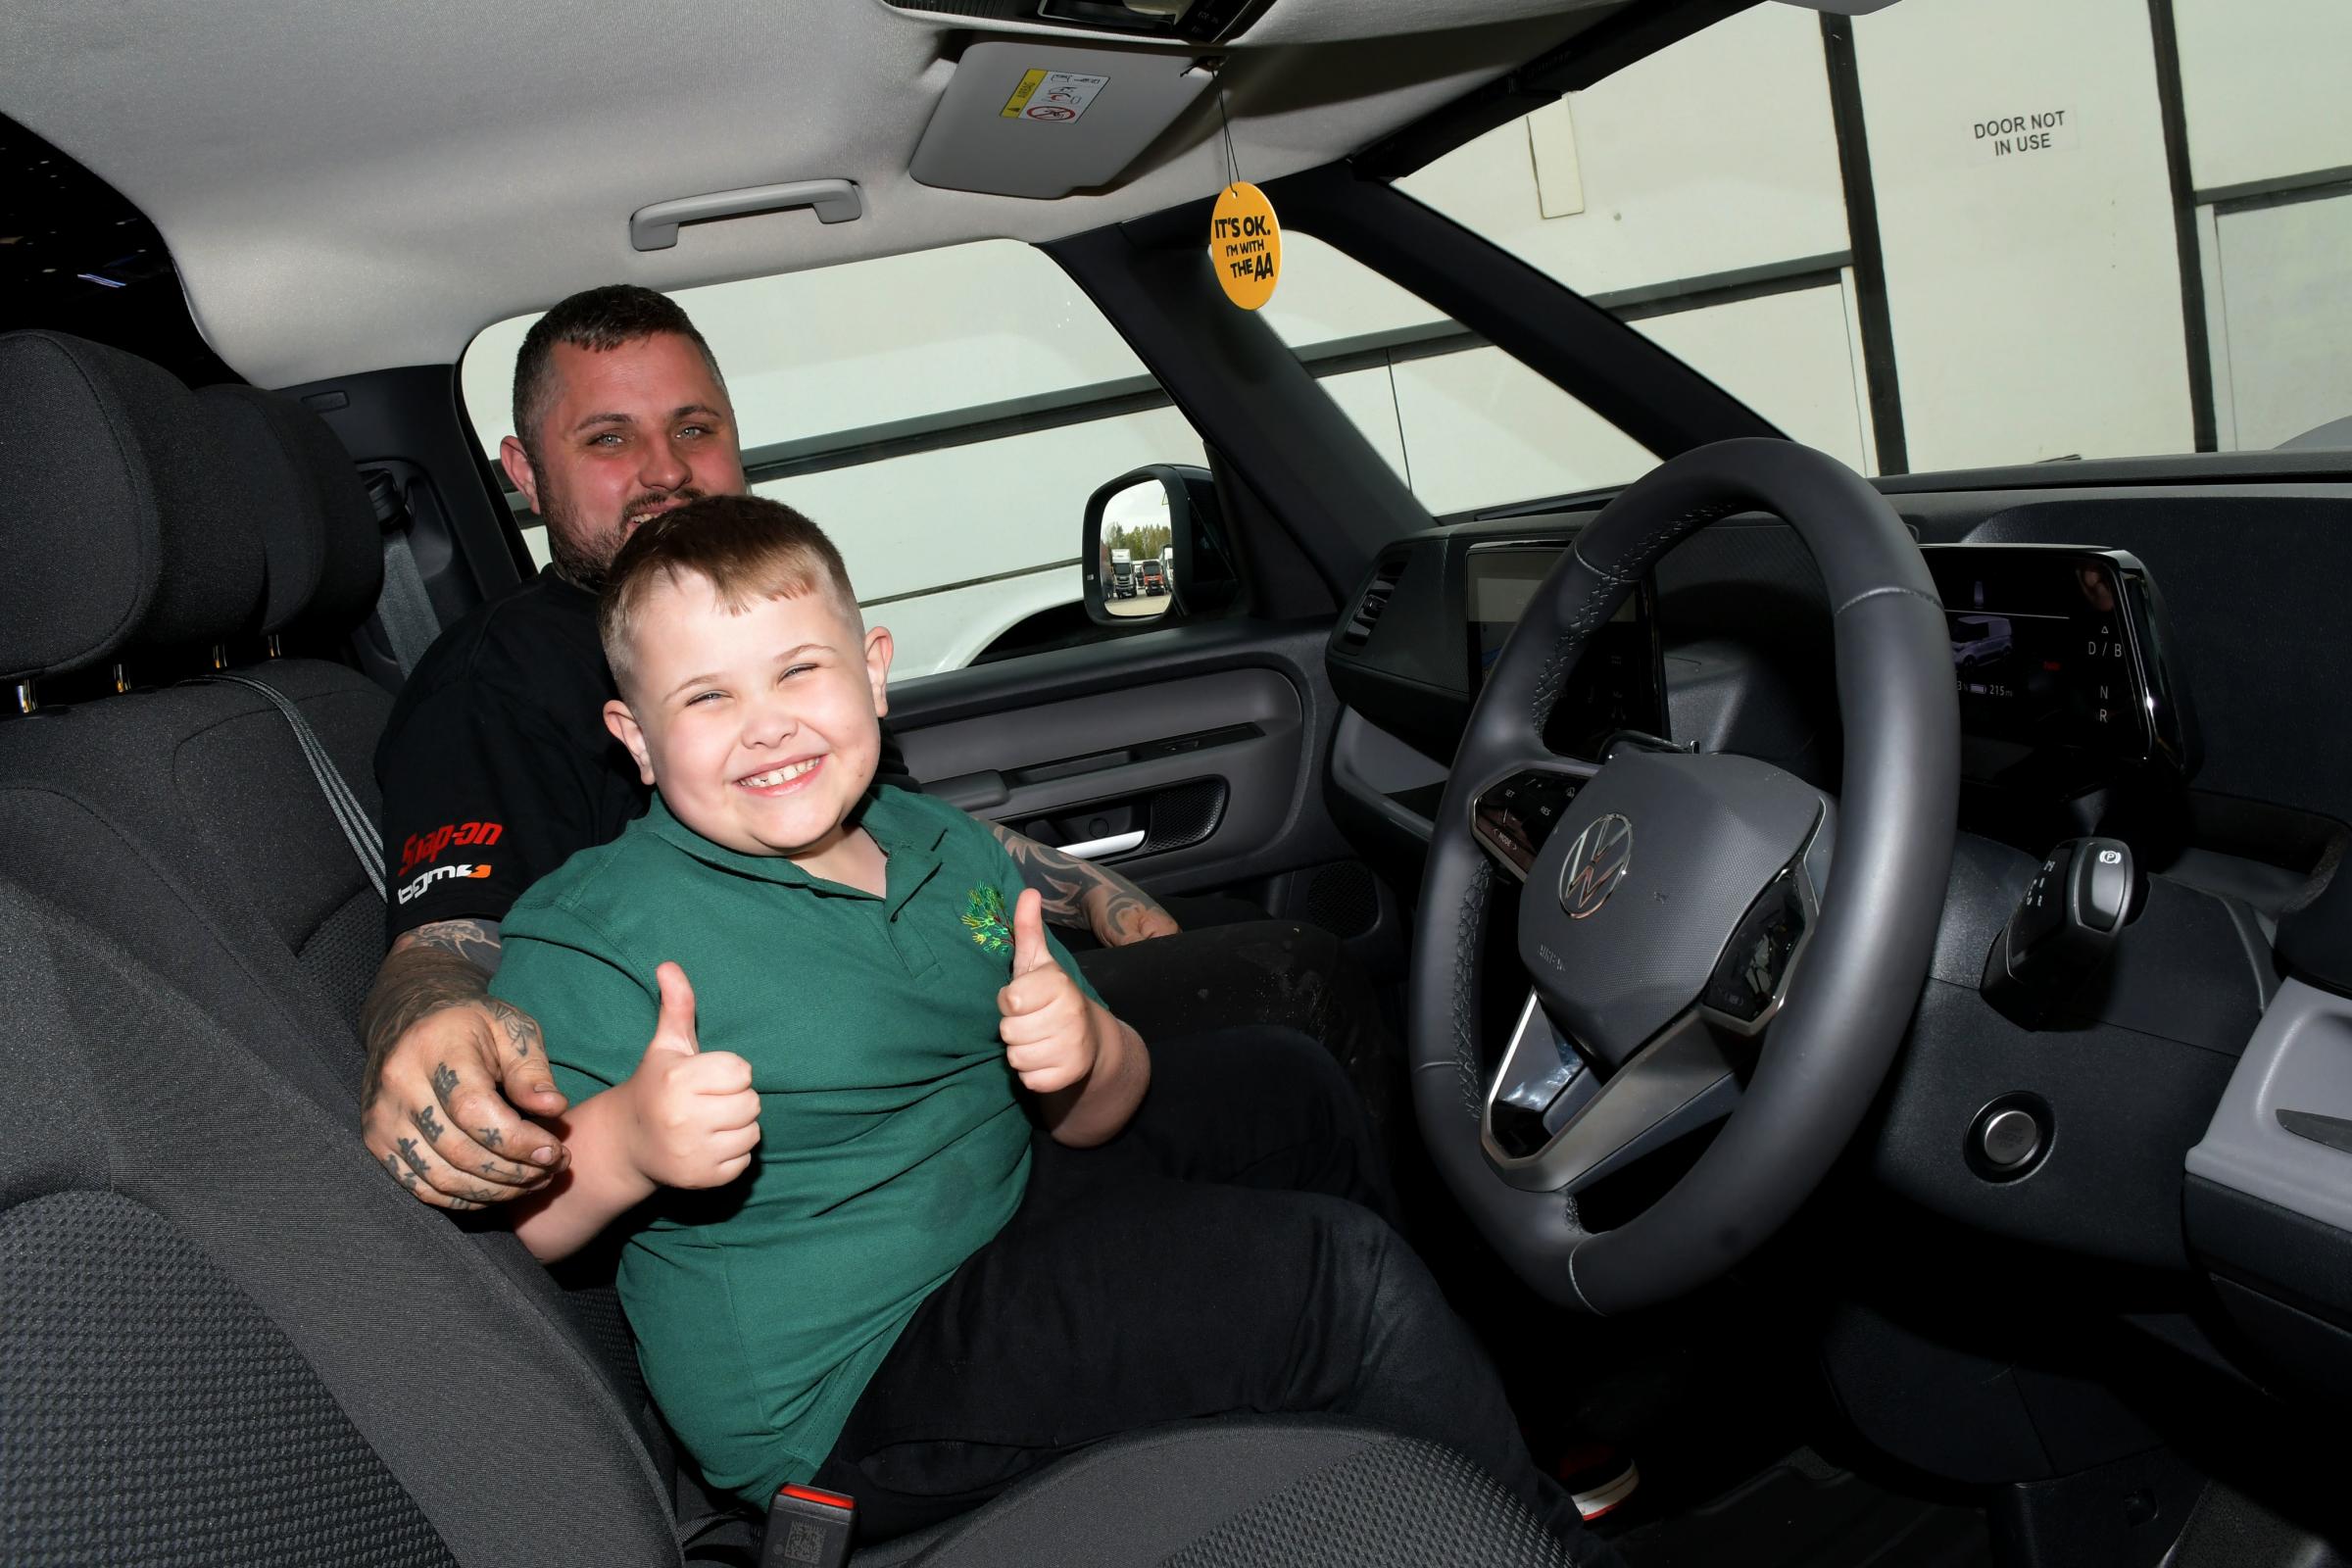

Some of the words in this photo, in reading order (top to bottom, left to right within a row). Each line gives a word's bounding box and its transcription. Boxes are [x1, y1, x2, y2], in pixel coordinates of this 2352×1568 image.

[1974, 117, 2026, 139] DOOR
[2031, 110, 2066, 130] NOT
[1994, 139, 2012, 157] IN
[2016, 132, 2052, 152] USE
[1214, 217, 1241, 239] IT'S
[1243, 216, 1271, 236] OK.
[1225, 243, 1239, 258] I'M
[1239, 239, 1265, 255] WITH
[1230, 258, 1253, 278] THE
[1253, 252, 1275, 282] AA
[2088, 641, 2097, 656] D
[2113, 643, 2123, 658] B
[2099, 685, 2108, 700] N
[2099, 709, 2108, 723] R
